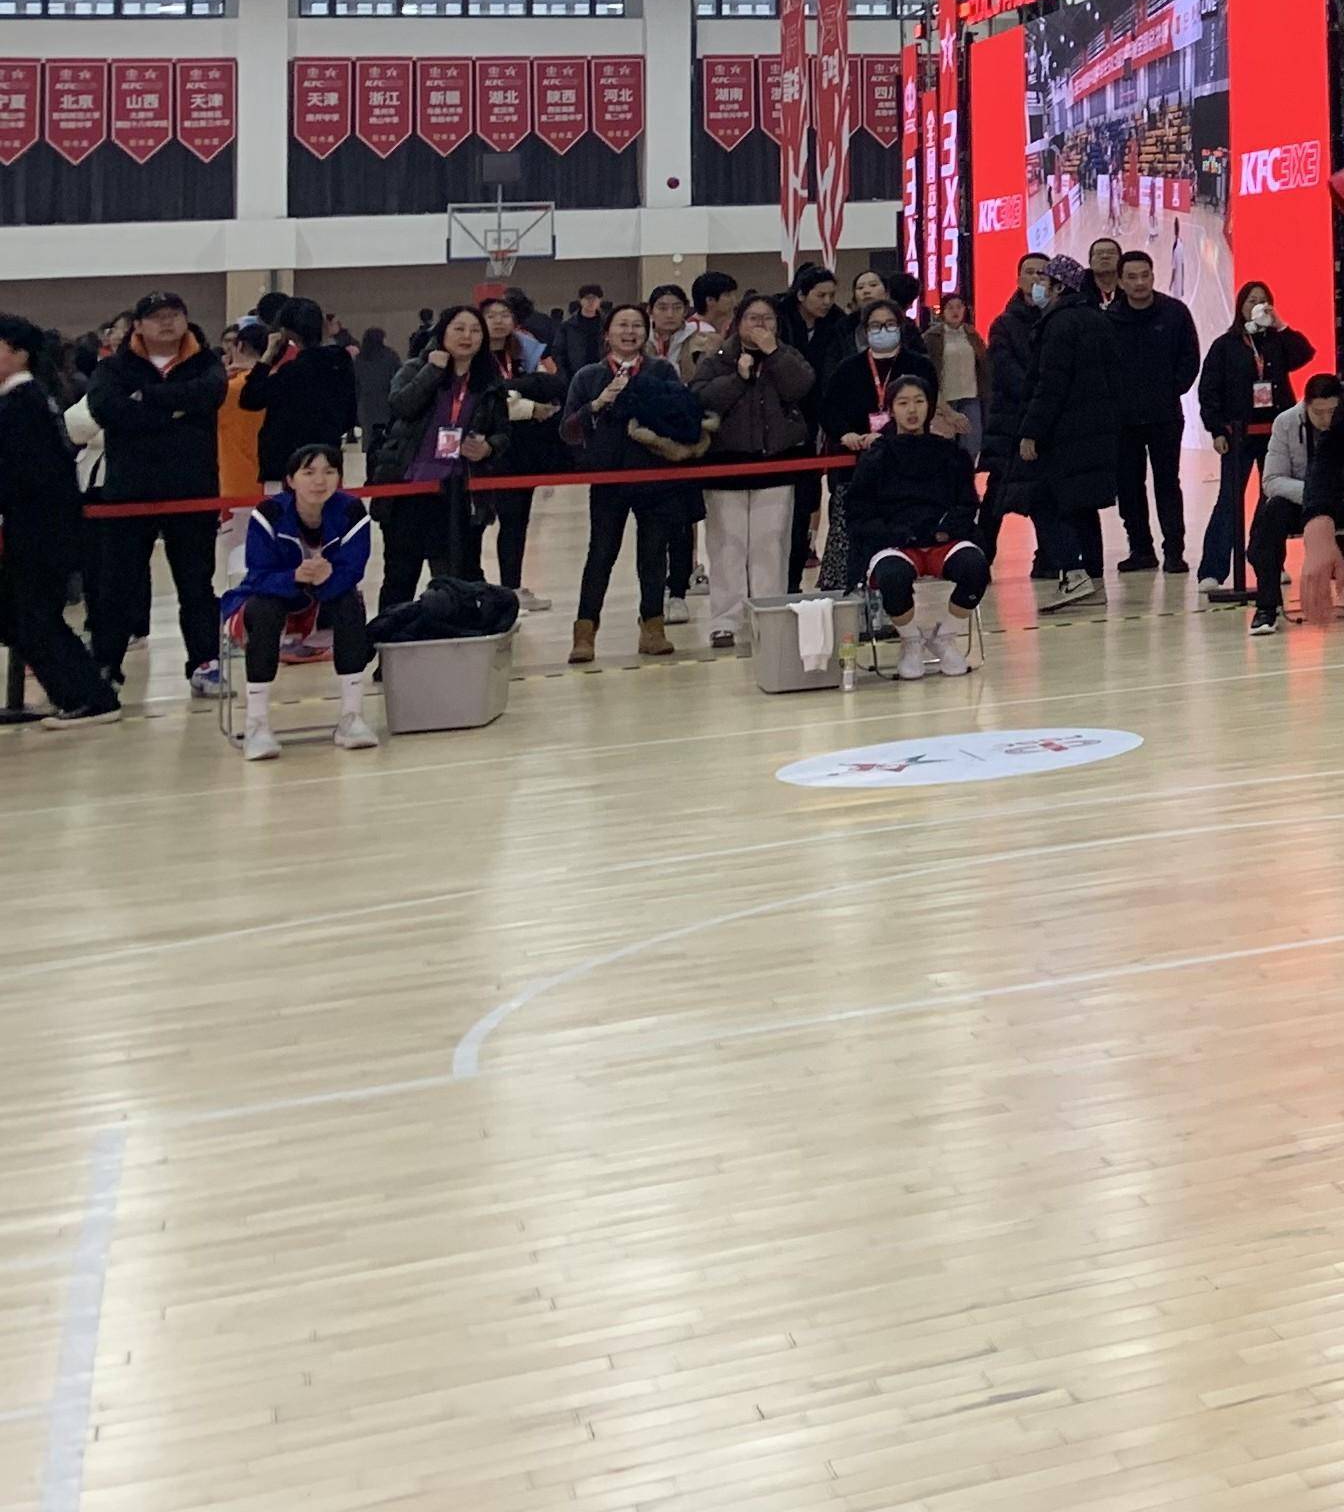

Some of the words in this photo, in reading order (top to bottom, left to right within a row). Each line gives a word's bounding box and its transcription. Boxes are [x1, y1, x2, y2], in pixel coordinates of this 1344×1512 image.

[59, 93, 95, 109] 北京
[125, 93, 160, 109] 山西
[190, 93, 224, 109] 天津
[306, 91, 340, 107] 天津
[368, 91, 401, 106] 浙江
[429, 90, 461, 105] 新疆
[488, 89, 520, 105] 湖北
[546, 89, 577, 104] 陕西
[603, 88, 634, 103] 河北
[715, 87, 744, 102] 湖南
[940, 109, 959, 293] 3X3
